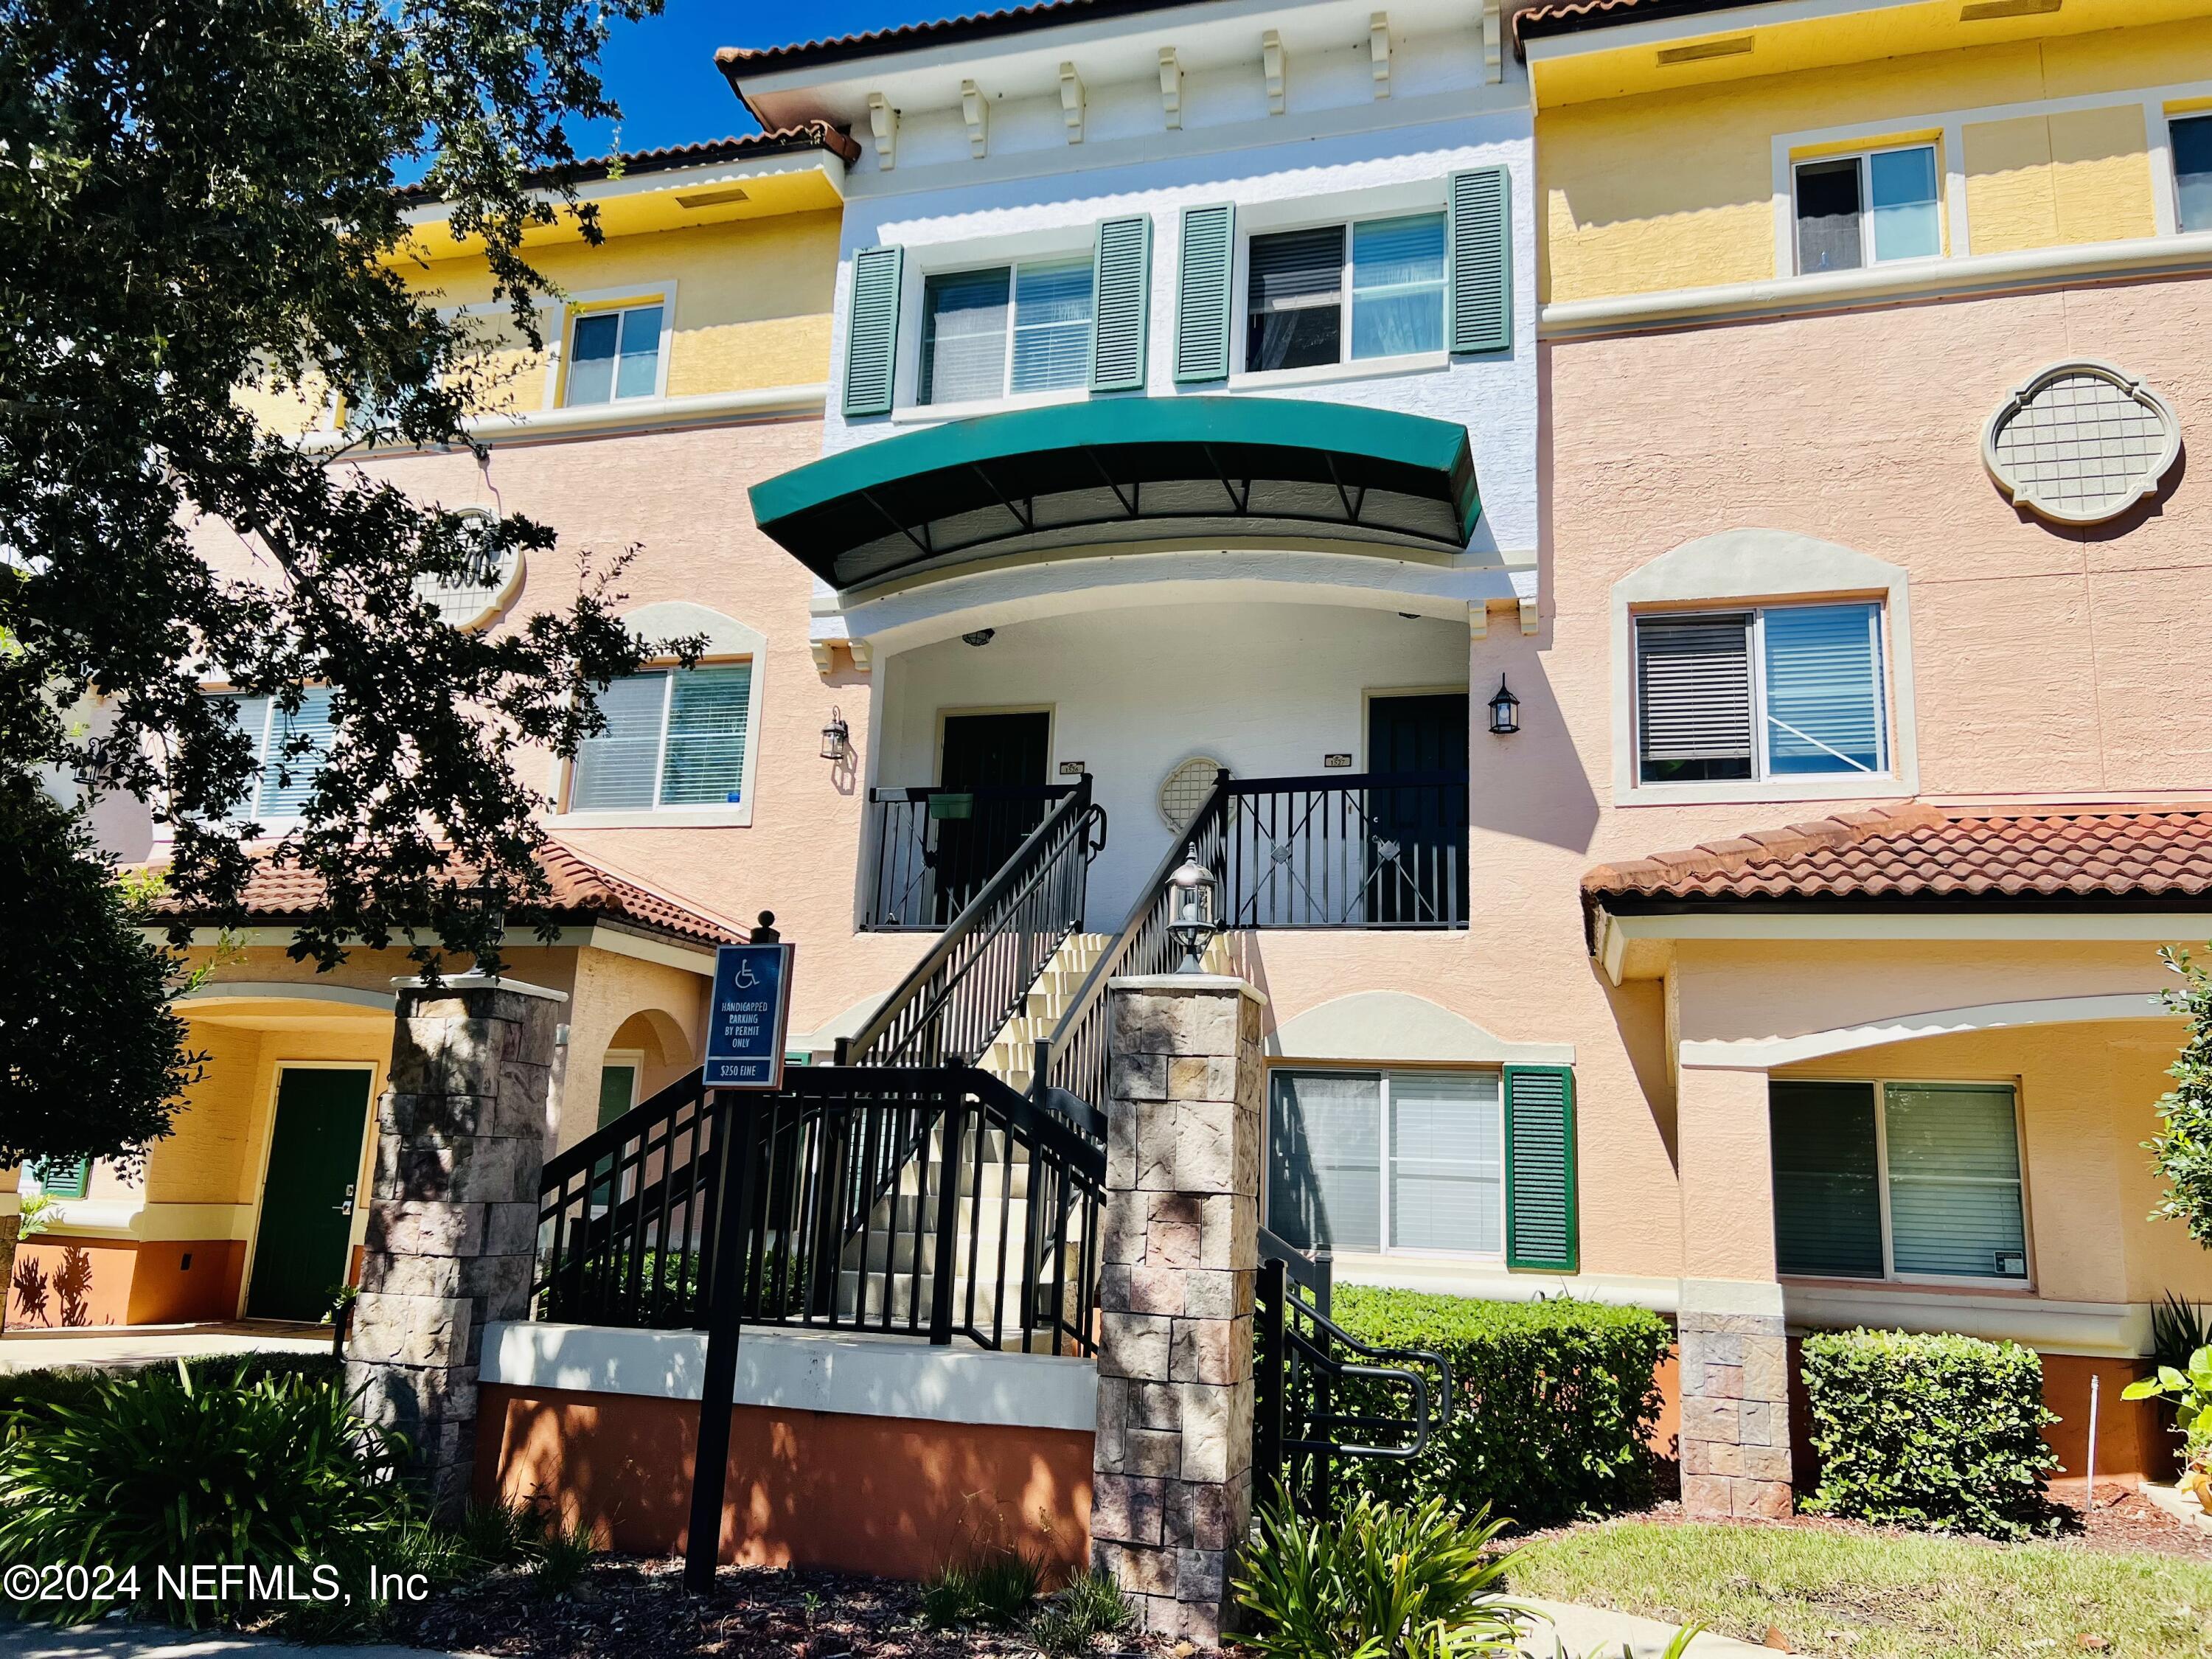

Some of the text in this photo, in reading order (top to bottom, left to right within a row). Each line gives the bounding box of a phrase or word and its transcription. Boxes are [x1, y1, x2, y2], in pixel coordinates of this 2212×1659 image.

[721, 1002, 768, 1012] HANDICAPPED
[729, 1014, 758, 1023] PARKING
[725, 1026, 759, 1036] BY PERMIT
[732, 1037, 751, 1048] ONLY
[720, 1065, 757, 1077] $250 FINE
